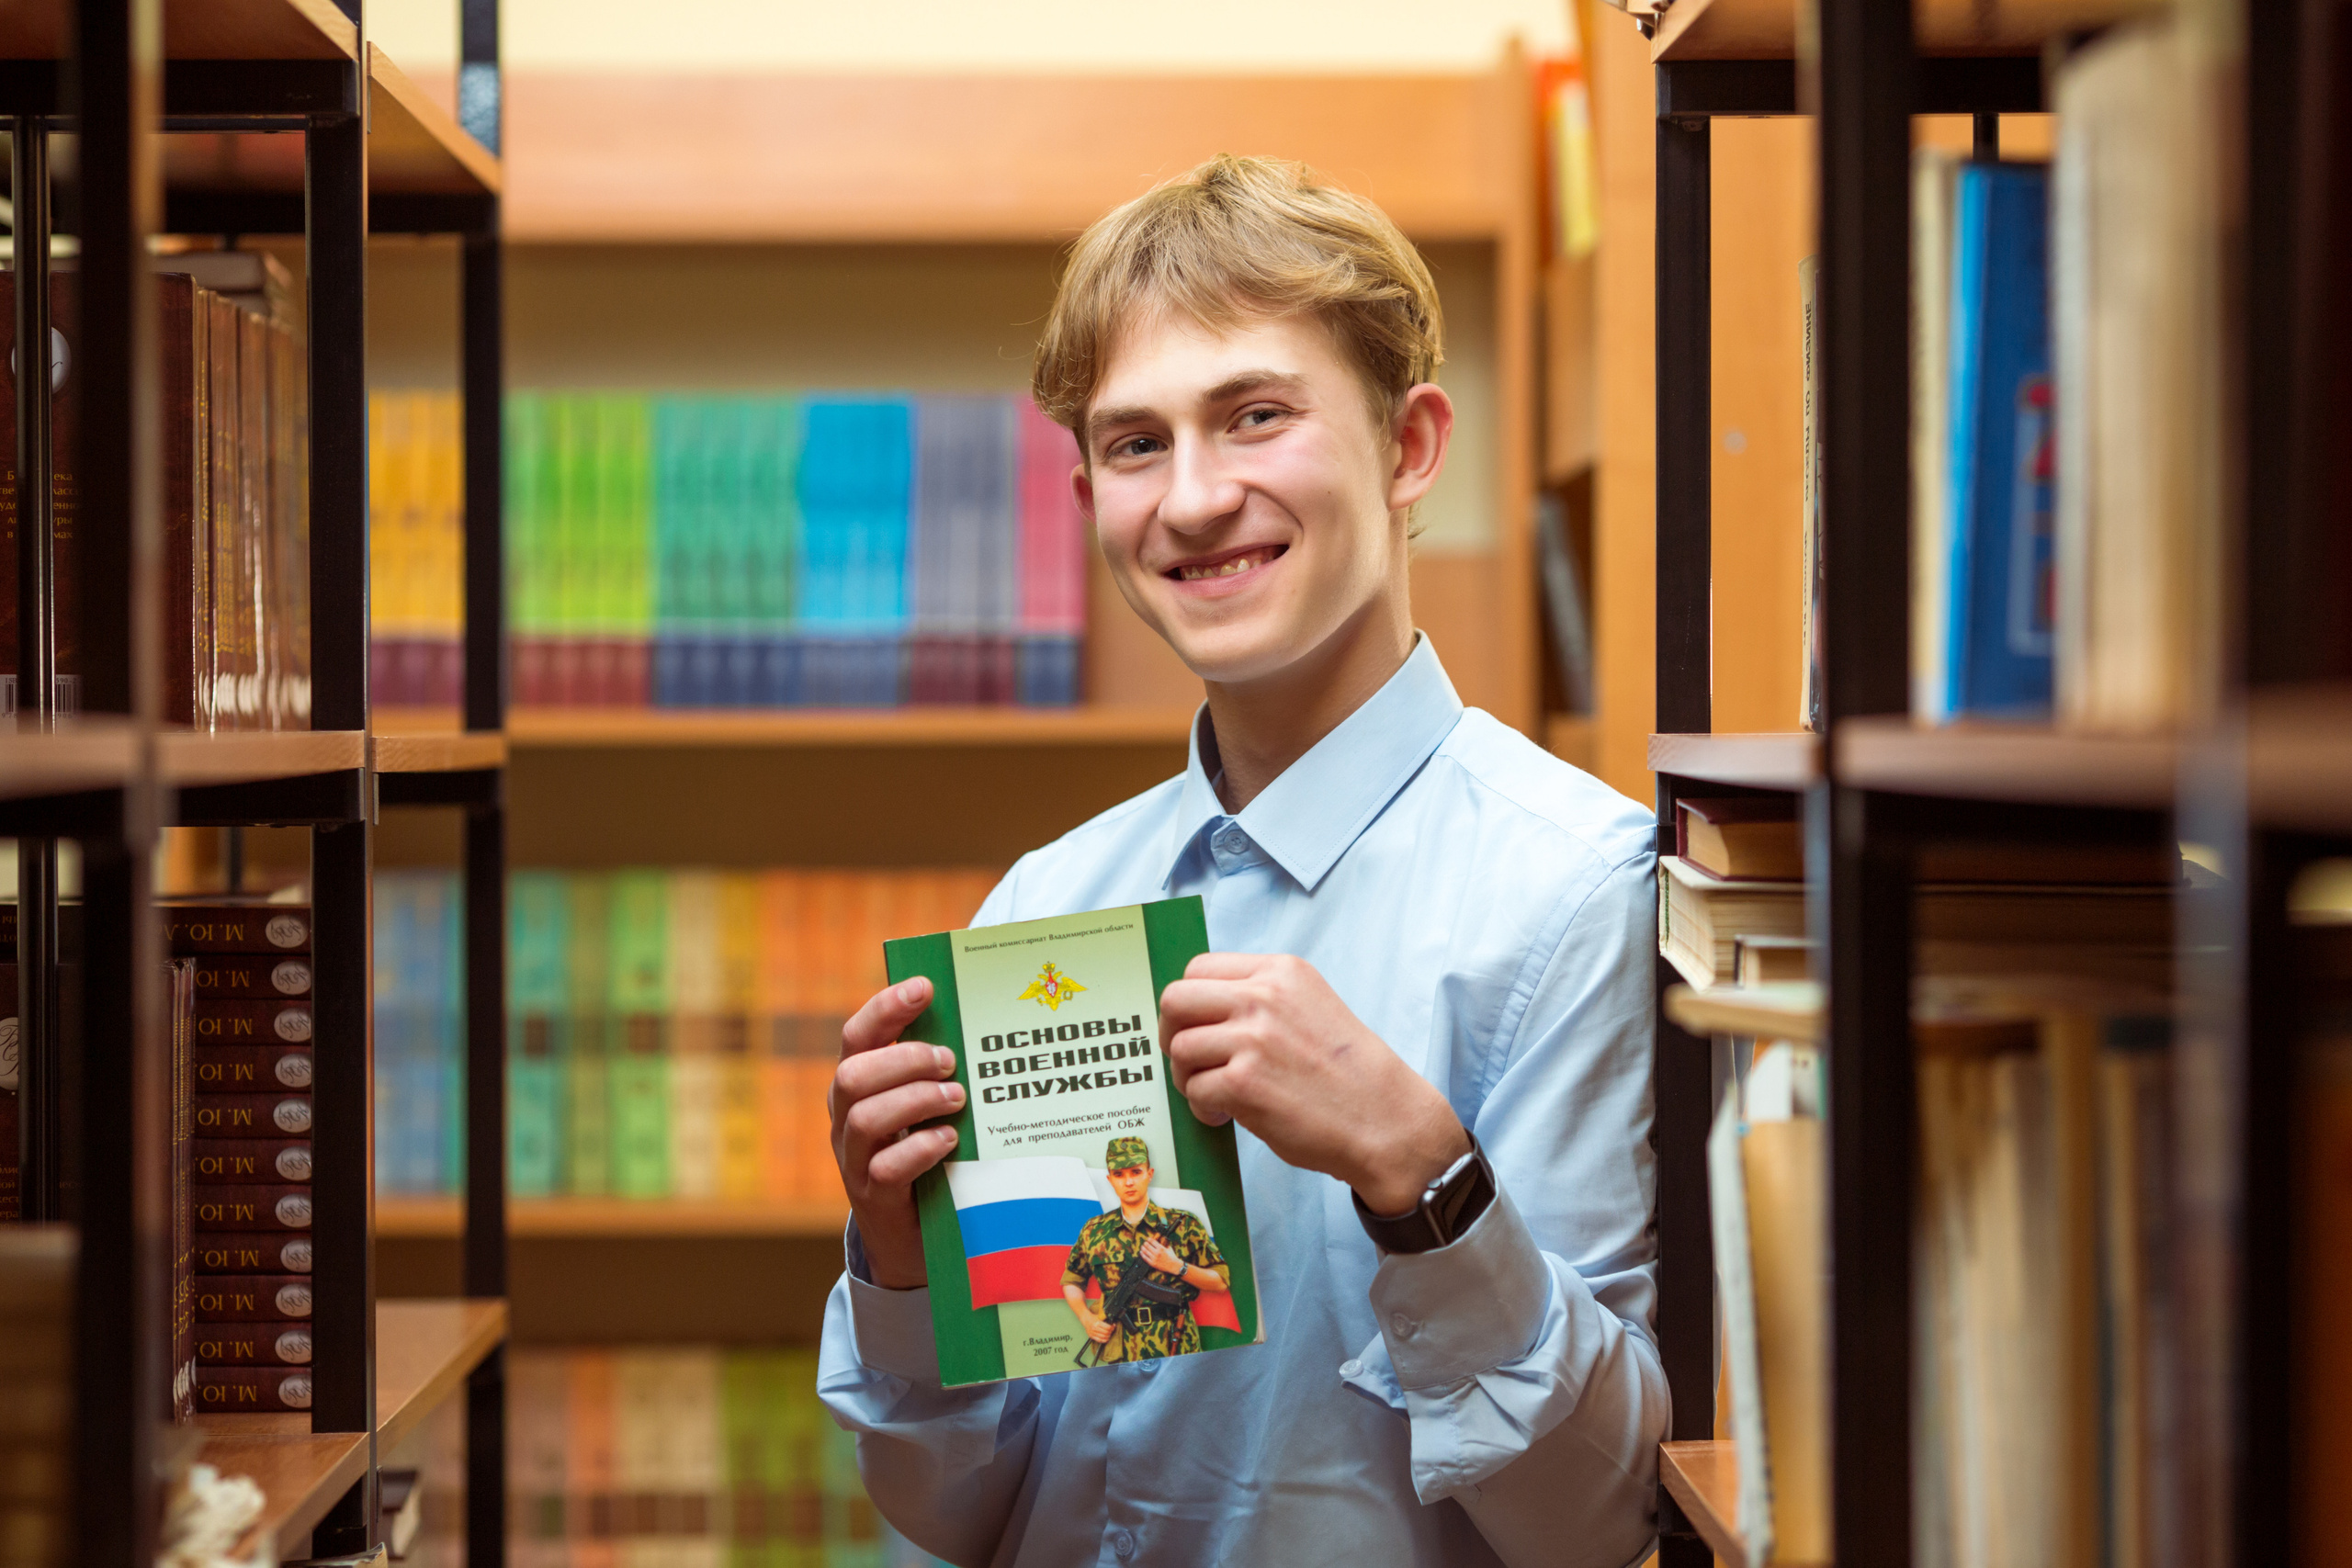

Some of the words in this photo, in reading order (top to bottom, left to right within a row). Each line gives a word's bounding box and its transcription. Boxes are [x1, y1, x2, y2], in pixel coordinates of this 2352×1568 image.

[220, 924, 244, 942] М.
[964, 942, 998, 953] Военный
[999, 936, 1047, 948] комиссариат
[1048, 928, 1103, 942] Владимирской
[1104, 923, 1134, 933] области
[196, 970, 219, 987] Ю
[198, 1018, 221, 1035] Ю
[980, 1014, 1142, 1053] ОСНОВЫ
[978, 1035, 1152, 1079] ВОЕННОЙ
[982, 1065, 1154, 1104] СЛУЖБЫ
[198, 1108, 220, 1126] Ю
[988, 1112, 1104, 1135] Учебно-методическое
[1107, 1105, 1151, 1120] пособие
[1002, 1135, 1023, 1147] для
[1028, 1123, 1112, 1144] преподавателей
[1117, 1117, 1146, 1130] ОБЖ
[234, 1250, 259, 1267] М.
[1034, 1347, 1052, 1357] 2007
[232, 1385, 256, 1402] М.
